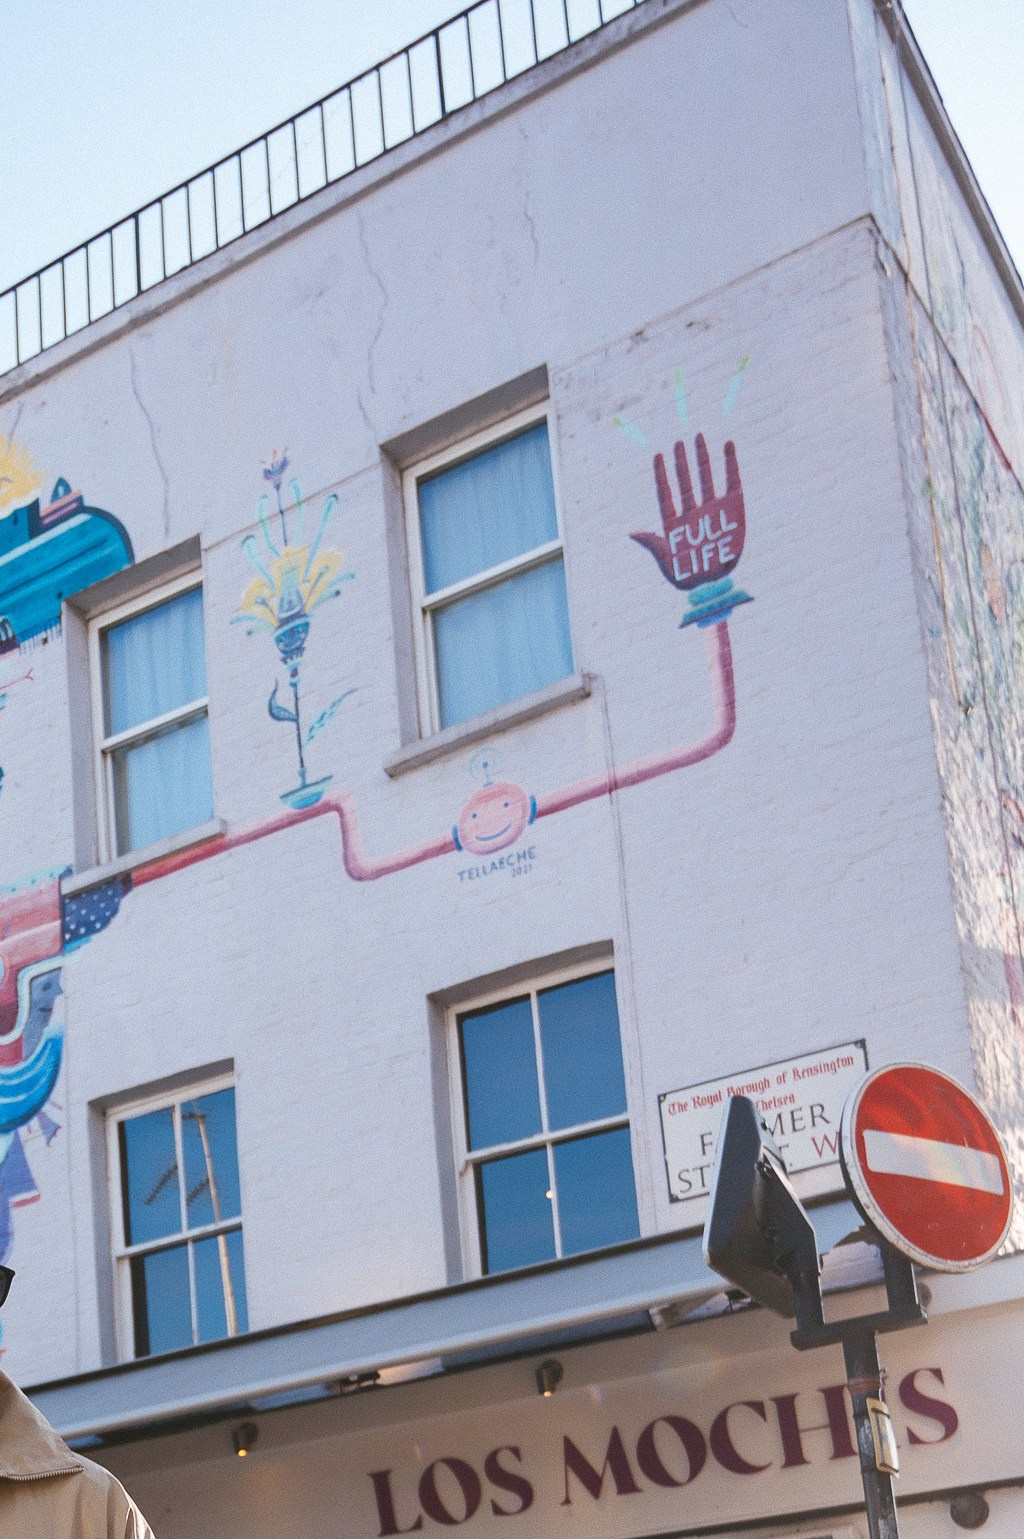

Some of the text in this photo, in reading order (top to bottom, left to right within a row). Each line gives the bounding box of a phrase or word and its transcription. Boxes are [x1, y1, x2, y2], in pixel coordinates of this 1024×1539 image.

[668, 509, 738, 555] FULL
[672, 535, 736, 582] LIFE
[668, 1055, 854, 1116] The Royal Borough of Kensington
[700, 1103, 830, 1155] FMER
[369, 1367, 959, 1537] LOS MOCHS
